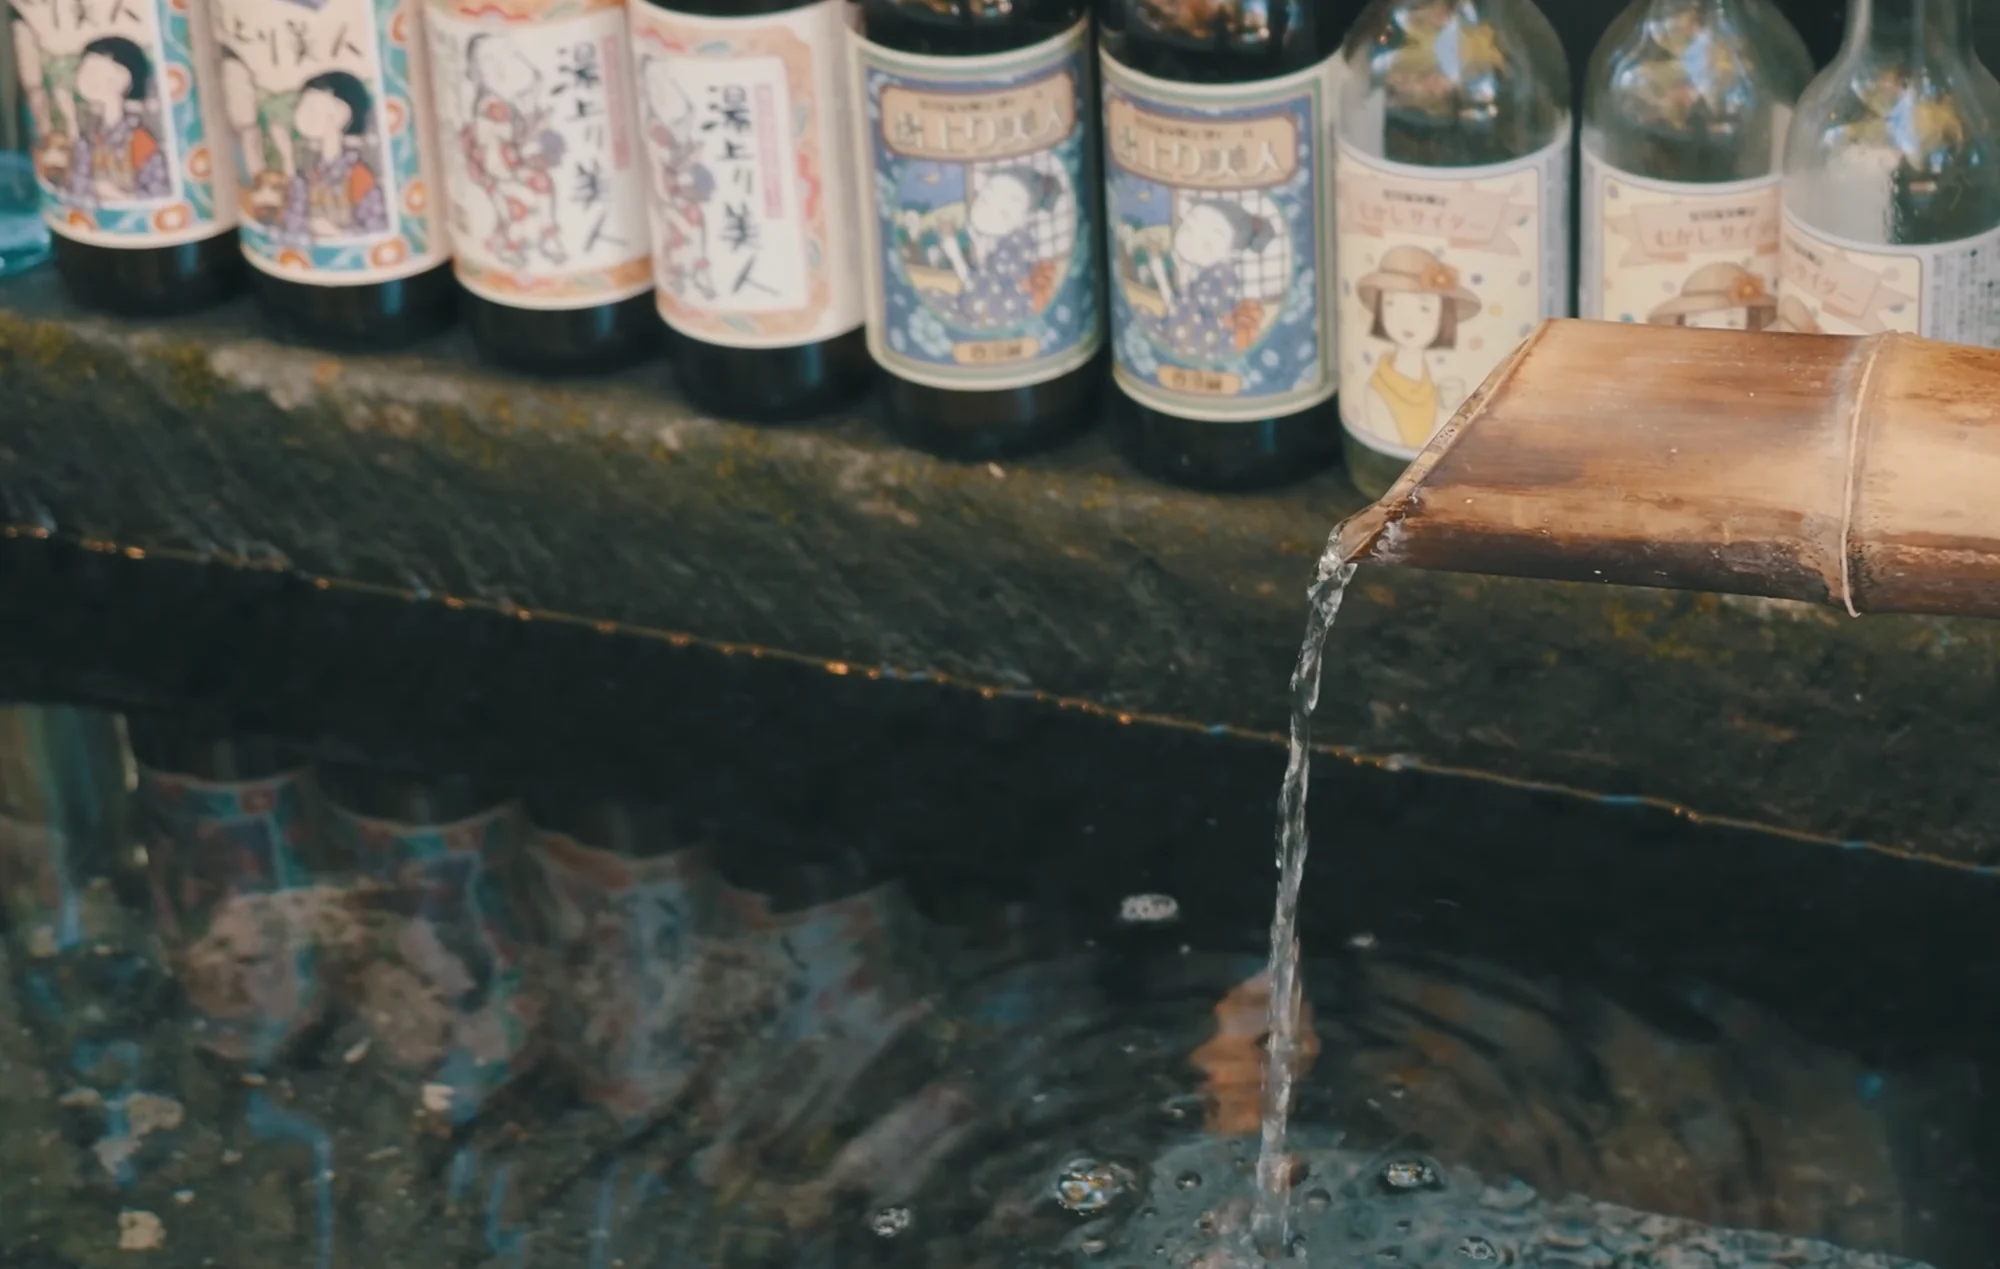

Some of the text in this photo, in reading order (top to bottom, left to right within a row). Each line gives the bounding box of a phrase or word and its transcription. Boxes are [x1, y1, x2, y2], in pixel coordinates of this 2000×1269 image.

[549, 41, 630, 252] 湯上り美人
[700, 84, 782, 293] 湯上り美人
